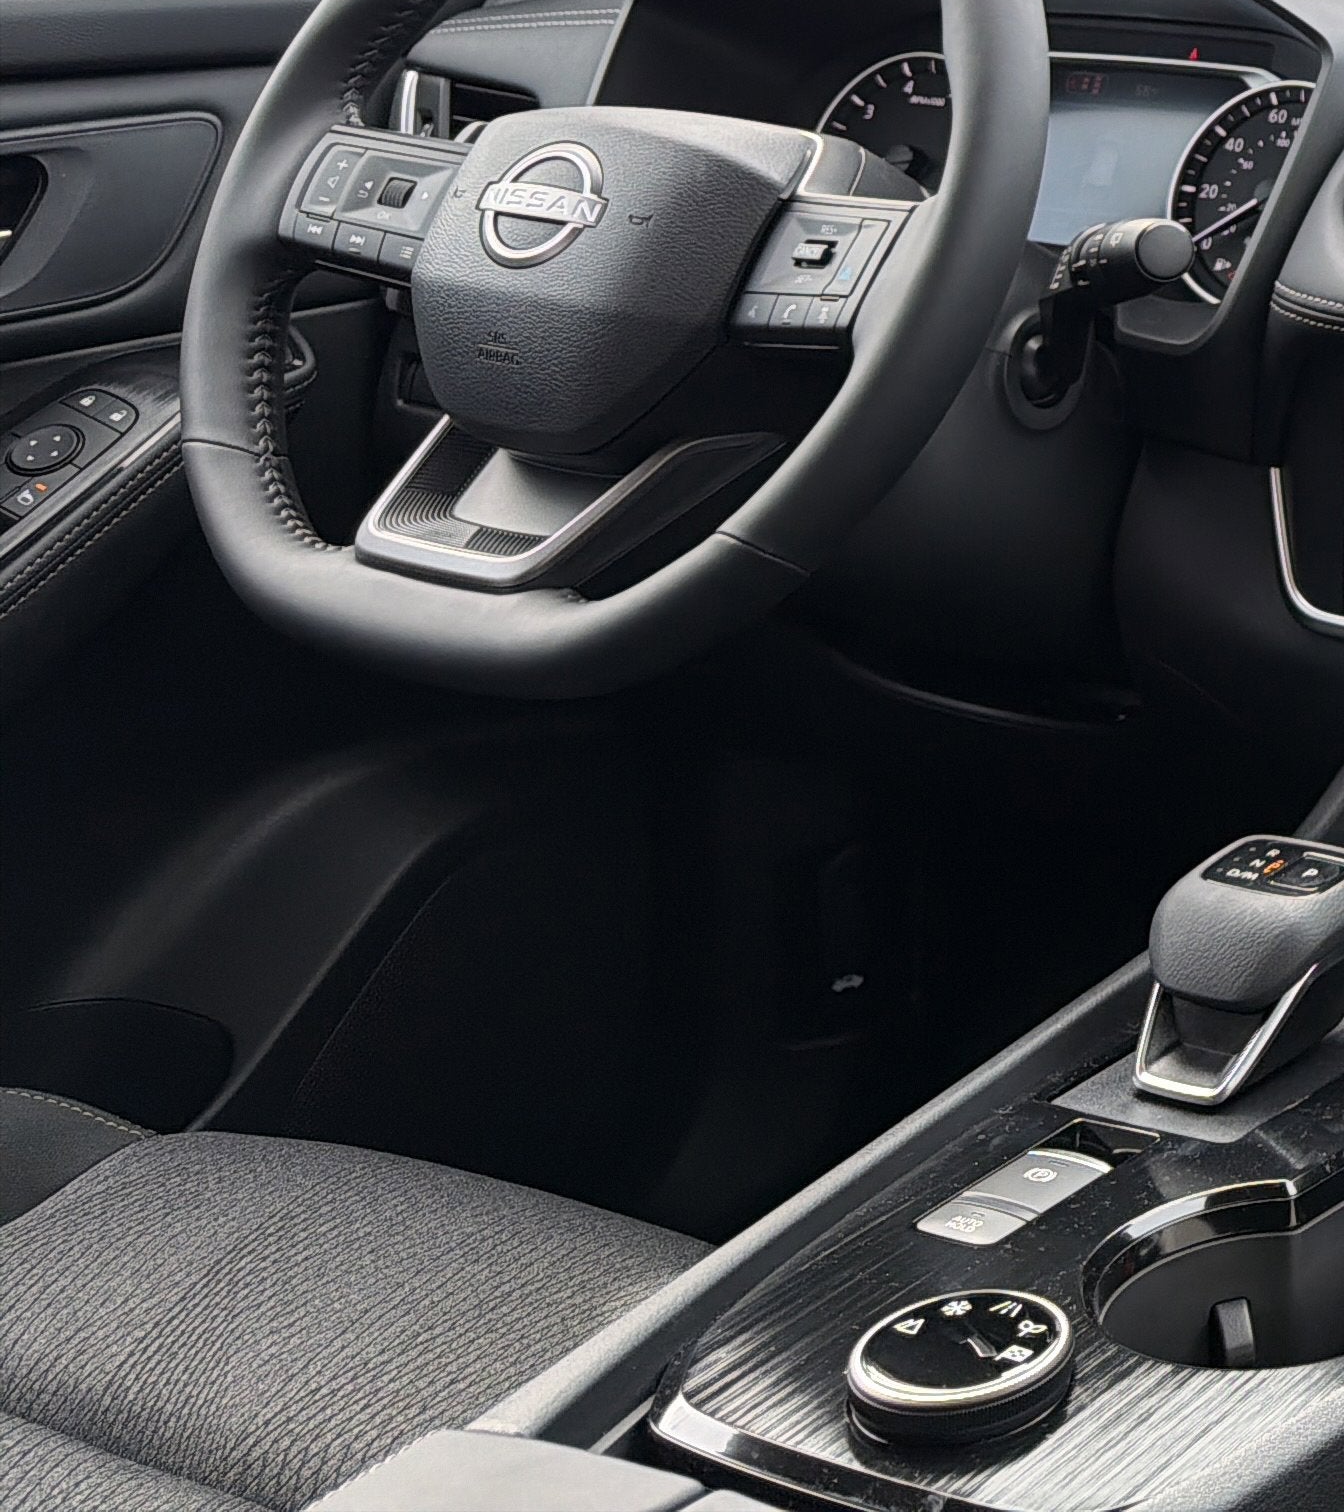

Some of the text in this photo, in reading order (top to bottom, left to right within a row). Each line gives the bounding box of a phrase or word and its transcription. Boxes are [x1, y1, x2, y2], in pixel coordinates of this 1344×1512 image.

[1268, 109, 1289, 125] 60
[1225, 137, 1245, 153] 40
[1199, 183, 1219, 200] 20
[480, 184, 602, 224] NISSAN
[1265, 848, 1281, 858] R
[1249, 858, 1267, 868] N
[1225, 868, 1260, 881] D/M
[1301, 867, 1319, 879] P
[944, 1221, 977, 1234] HOLD
[951, 1215, 984, 1228] AUTO
